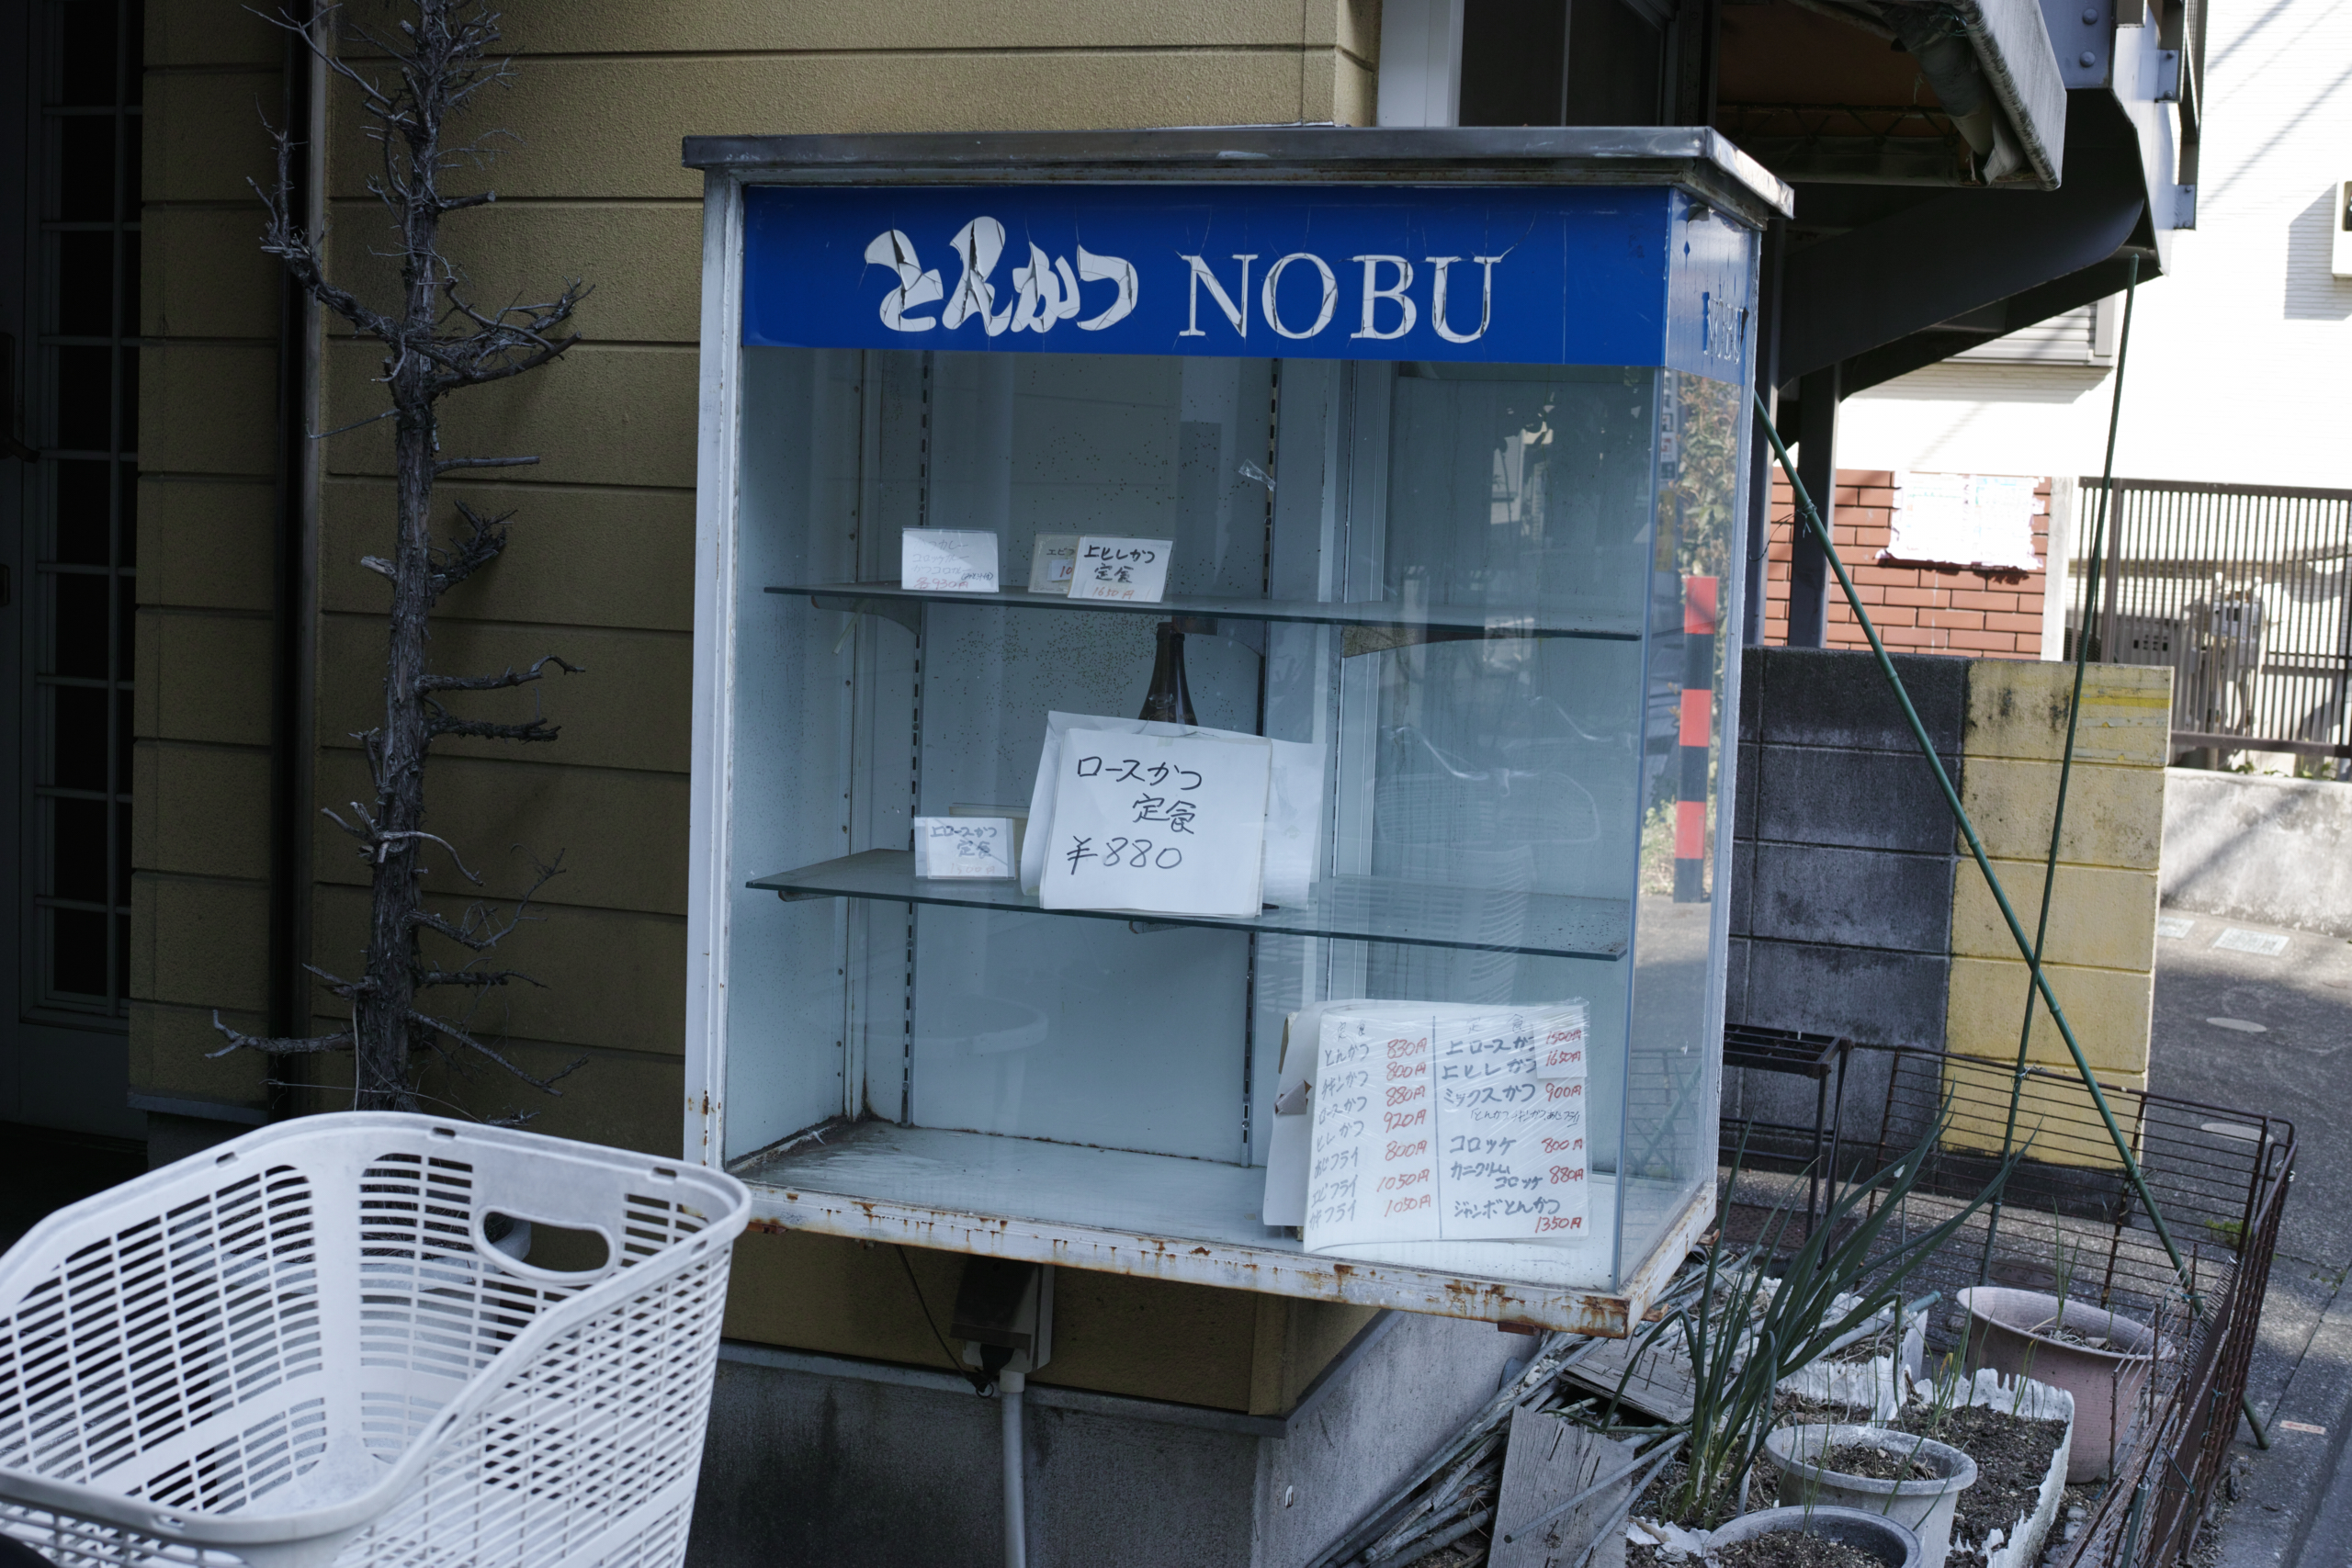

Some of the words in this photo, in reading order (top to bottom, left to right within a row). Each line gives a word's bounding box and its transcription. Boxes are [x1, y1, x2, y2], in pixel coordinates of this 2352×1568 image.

[865, 216, 1138, 336] とんかつ
[1176, 253, 1502, 343] NOBU
[1084, 545, 1155, 563] 上ヒレかつ
[1094, 563, 1134, 583] 定食
[1077, 756, 1202, 791] ロースかつ
[1132, 793, 1196, 834] 定食
[957, 840, 992, 859] 定食
[1067, 835, 1182, 875] ¥880
[1325, 1043, 1369, 1066] とんかつ
[1387, 1037, 1427, 1059] 830円
[1386, 1062, 1426, 1081] 800円
[1385, 1086, 1425, 1107] 880円
[1443, 1084, 1535, 1107] ミックスかつ
[1545, 1082, 1581, 1102] 900円
[1317, 1121, 1364, 1153] ヒレかつ
[1384, 1109, 1427, 1134] 920円
[1449, 1135, 1517, 1156] コロッケ
[1542, 1137, 1582, 1153] 800円
[1314, 1146, 1358, 1179] あじフライ
[1385, 1140, 1427, 1161] 800円
[1494, 1176, 1543, 1190] コロッケ
[1549, 1166, 1584, 1184] 880円
[1311, 1174, 1358, 1208] エビフライ
[1376, 1168, 1430, 1192] 1050円
[1385, 1194, 1430, 1217] 1050円
[1454, 1196, 1560, 1219] ジャンボとんかつ
[1535, 1216, 1582, 1233] 1350円
